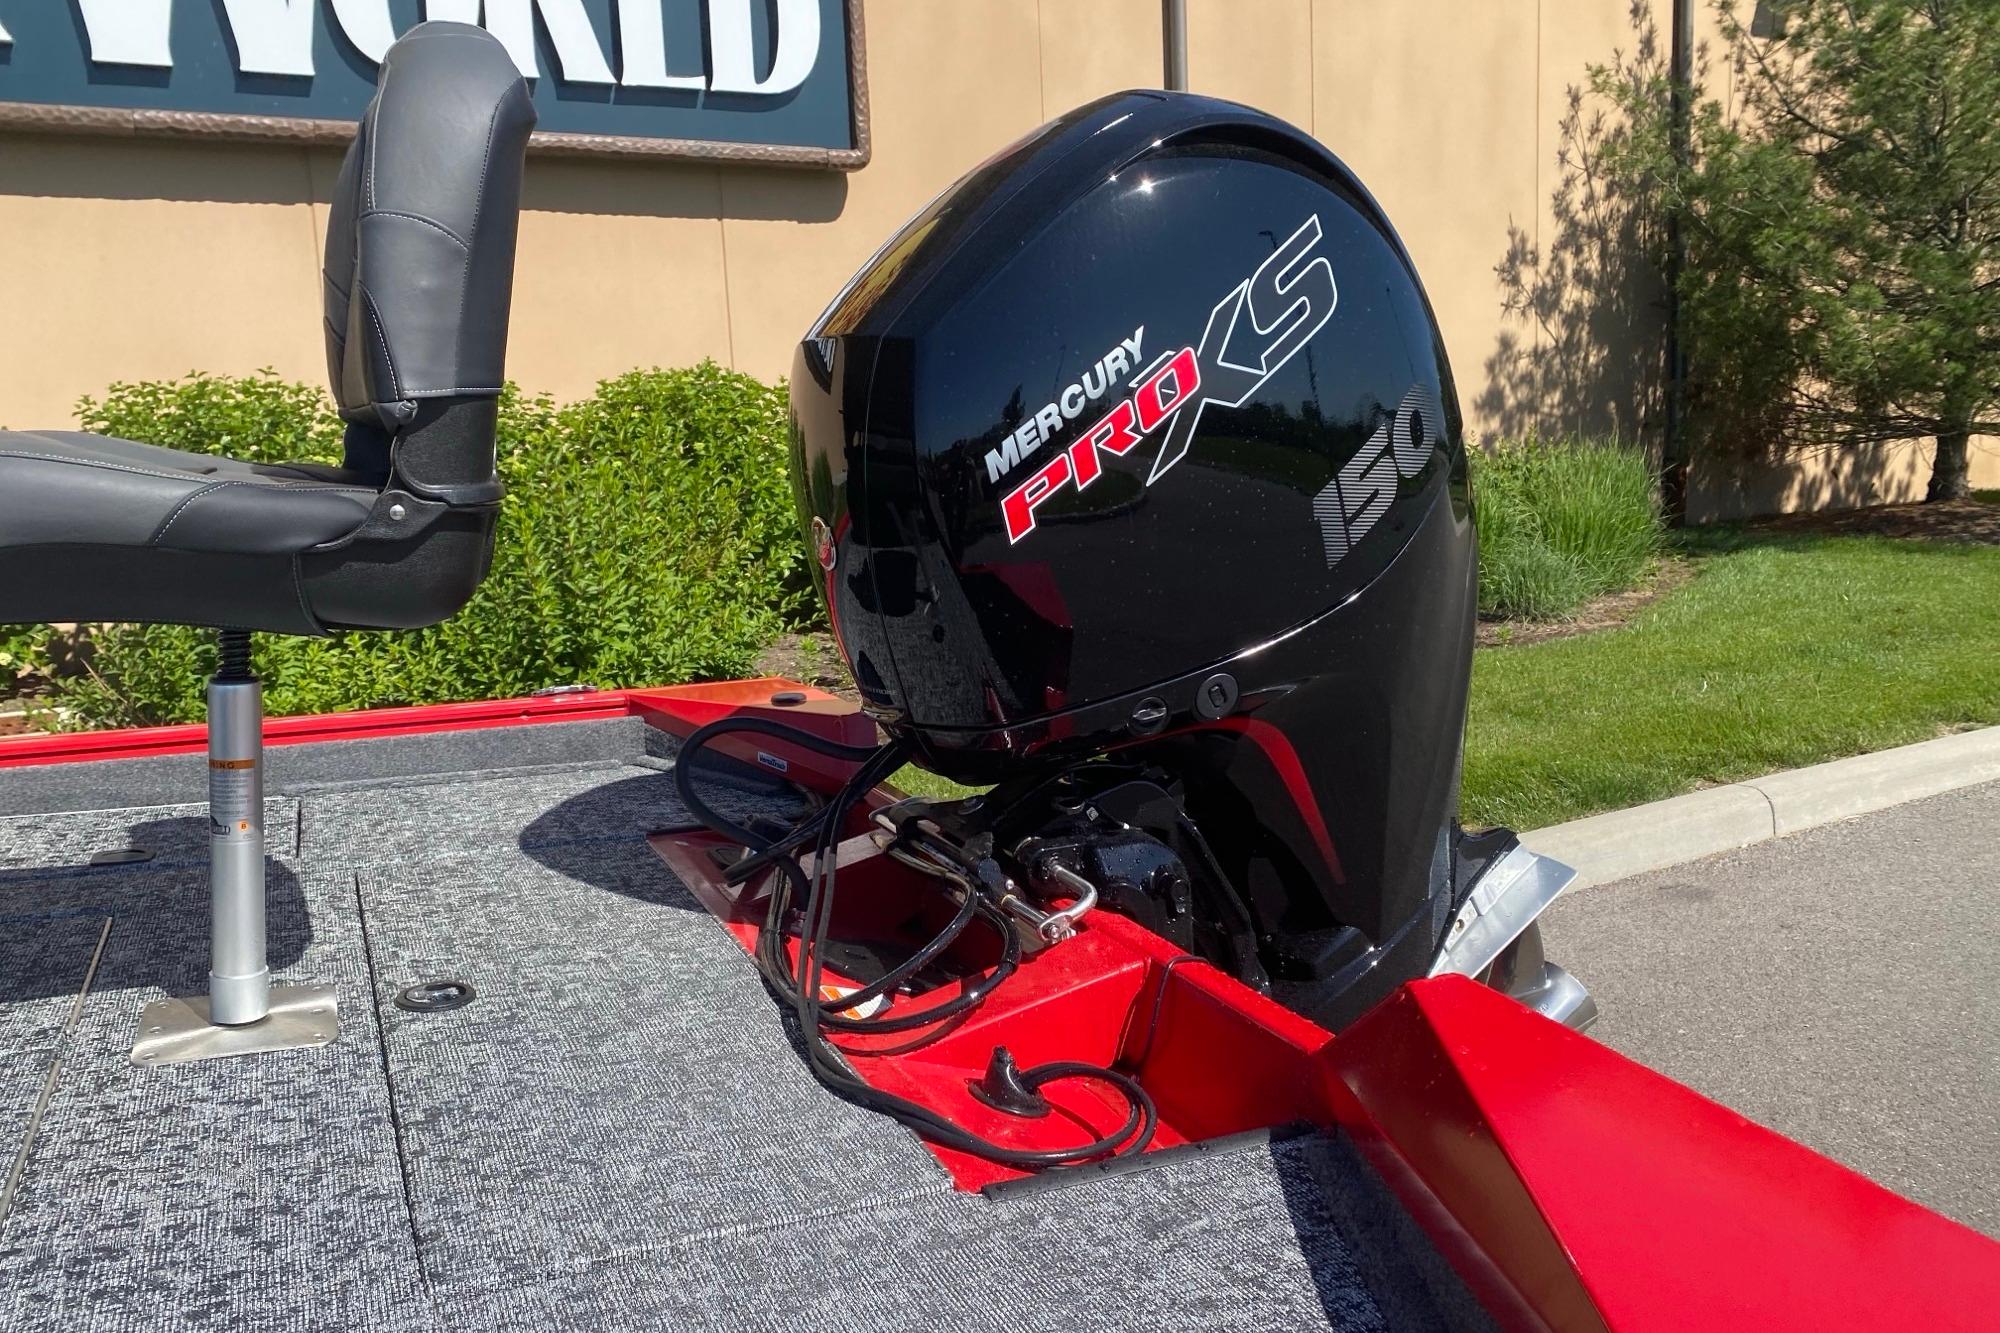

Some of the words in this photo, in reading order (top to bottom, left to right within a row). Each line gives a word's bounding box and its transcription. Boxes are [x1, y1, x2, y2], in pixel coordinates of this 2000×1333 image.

[77, 0, 820, 93] WRLD
[984, 325, 1144, 484] MERCURY
[1000, 346, 1200, 546] PRO
[1129, 213, 1338, 487] XS
[1313, 383, 1437, 570] 150
